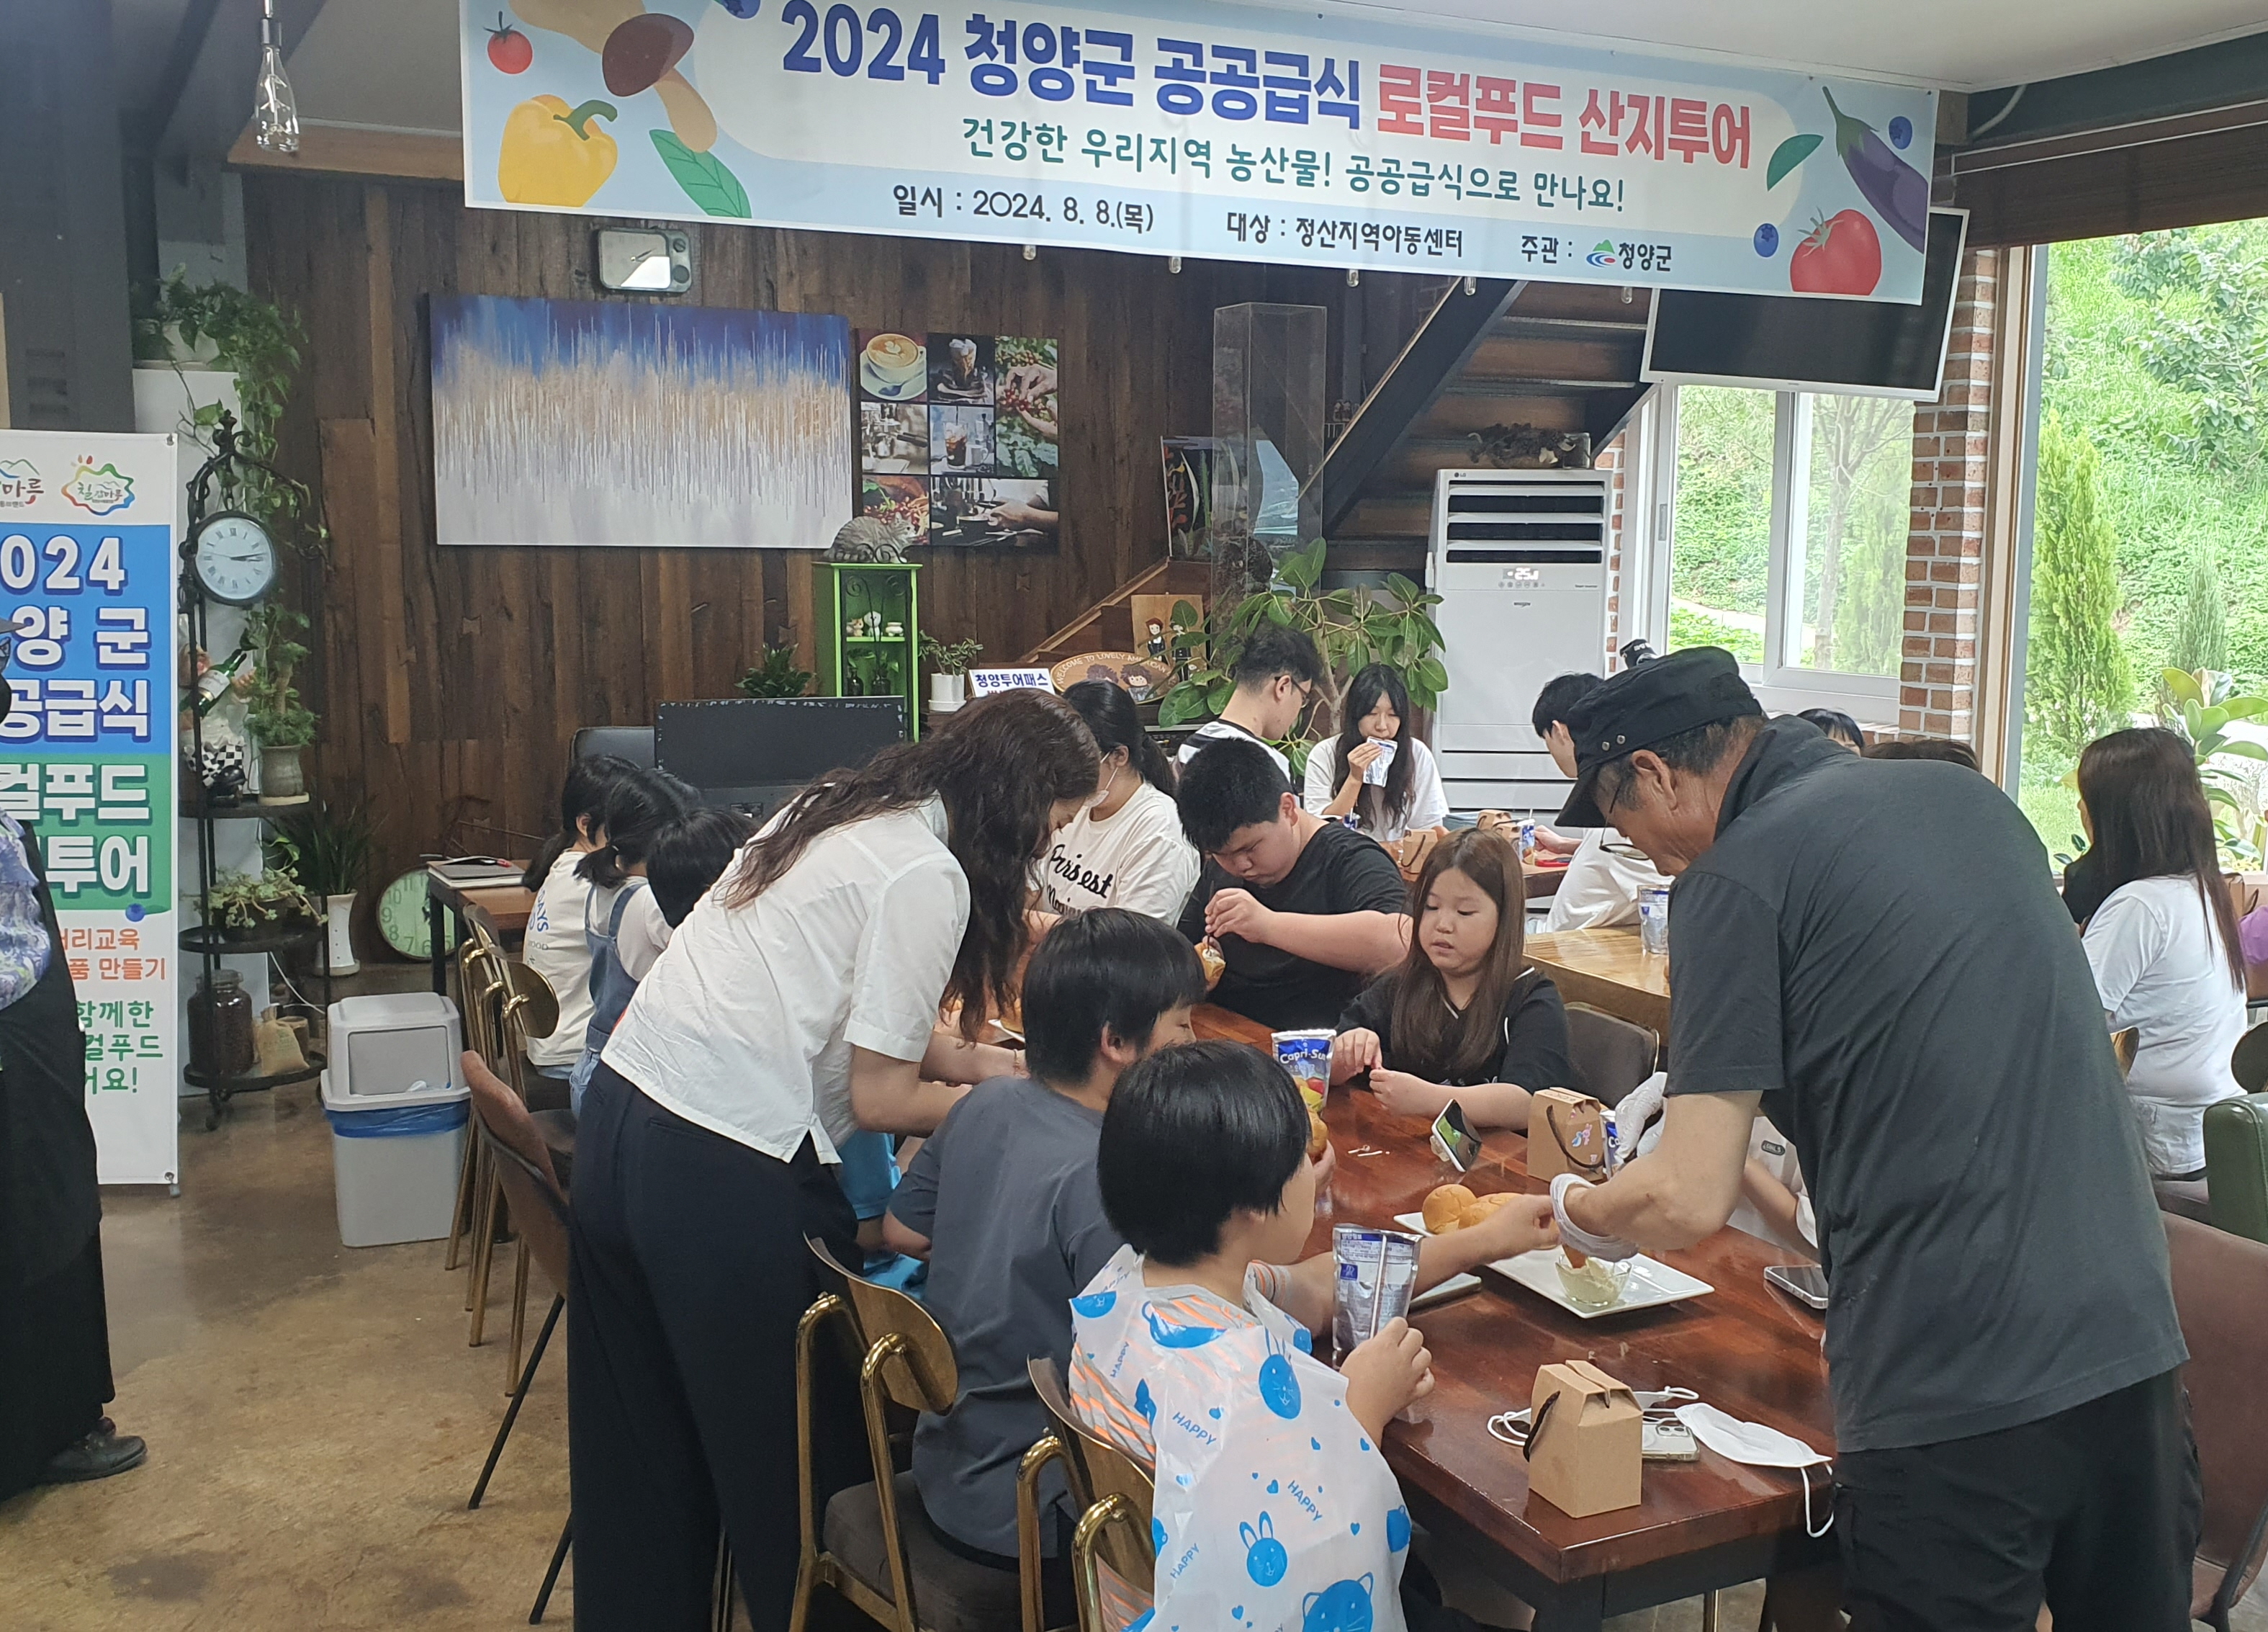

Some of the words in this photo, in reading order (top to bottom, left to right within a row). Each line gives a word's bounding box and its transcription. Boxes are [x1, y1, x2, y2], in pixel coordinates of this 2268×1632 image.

[781, 0, 945, 85] 2024
[964, 13, 1135, 107] 청양군
[1154, 37, 1360, 130] 공공급식
[1377, 63, 1563, 150] 로컬푸드
[1578, 89, 1750, 169] 산지투어
[963, 118, 1068, 164] 건강한
[1081, 129, 1212, 179] 우리지역
[1226, 143, 1331, 187] 농산물!
[1346, 154, 1521, 202] 공공급식으로
[1534, 171, 1624, 212] 만나요!
[893, 184, 943, 218] 일시
[973, 190, 1051, 223] 2024.
[1063, 197, 1084, 225] 8.
[1096, 199, 1154, 234] 8.(목)
[1227, 212, 1271, 243] 대상
[1295, 217, 1463, 258] 정산지역아동센터
[1521, 235, 1560, 264] 주관
[1618, 242, 1673, 272] 청양군
[0, 478, 44, 504] 마루
[0, 534, 126, 591] 024
[975, 673, 1049, 689] 청양투어패스
[1058, 660, 1083, 684] WELCOME
[0, 679, 148, 737] 공급식
[0, 763, 150, 820] 컬푸드
[38, 835, 148, 892] 투어
[382, 907, 392, 923] 9
[389, 889, 402, 905] 10
[390, 925, 400, 941] 8
[404, 936, 414, 951] 7
[99, 957, 166, 980] 만들기
[86, 1034, 163, 1062] 컬푸드
[1110, 1342, 1130, 1378] HAPPY
[1172, 1412, 1217, 1445] HAPPY
[1287, 1479, 1323, 1522] HAPPY
[1169, 1543, 1200, 1579] HAPPY
